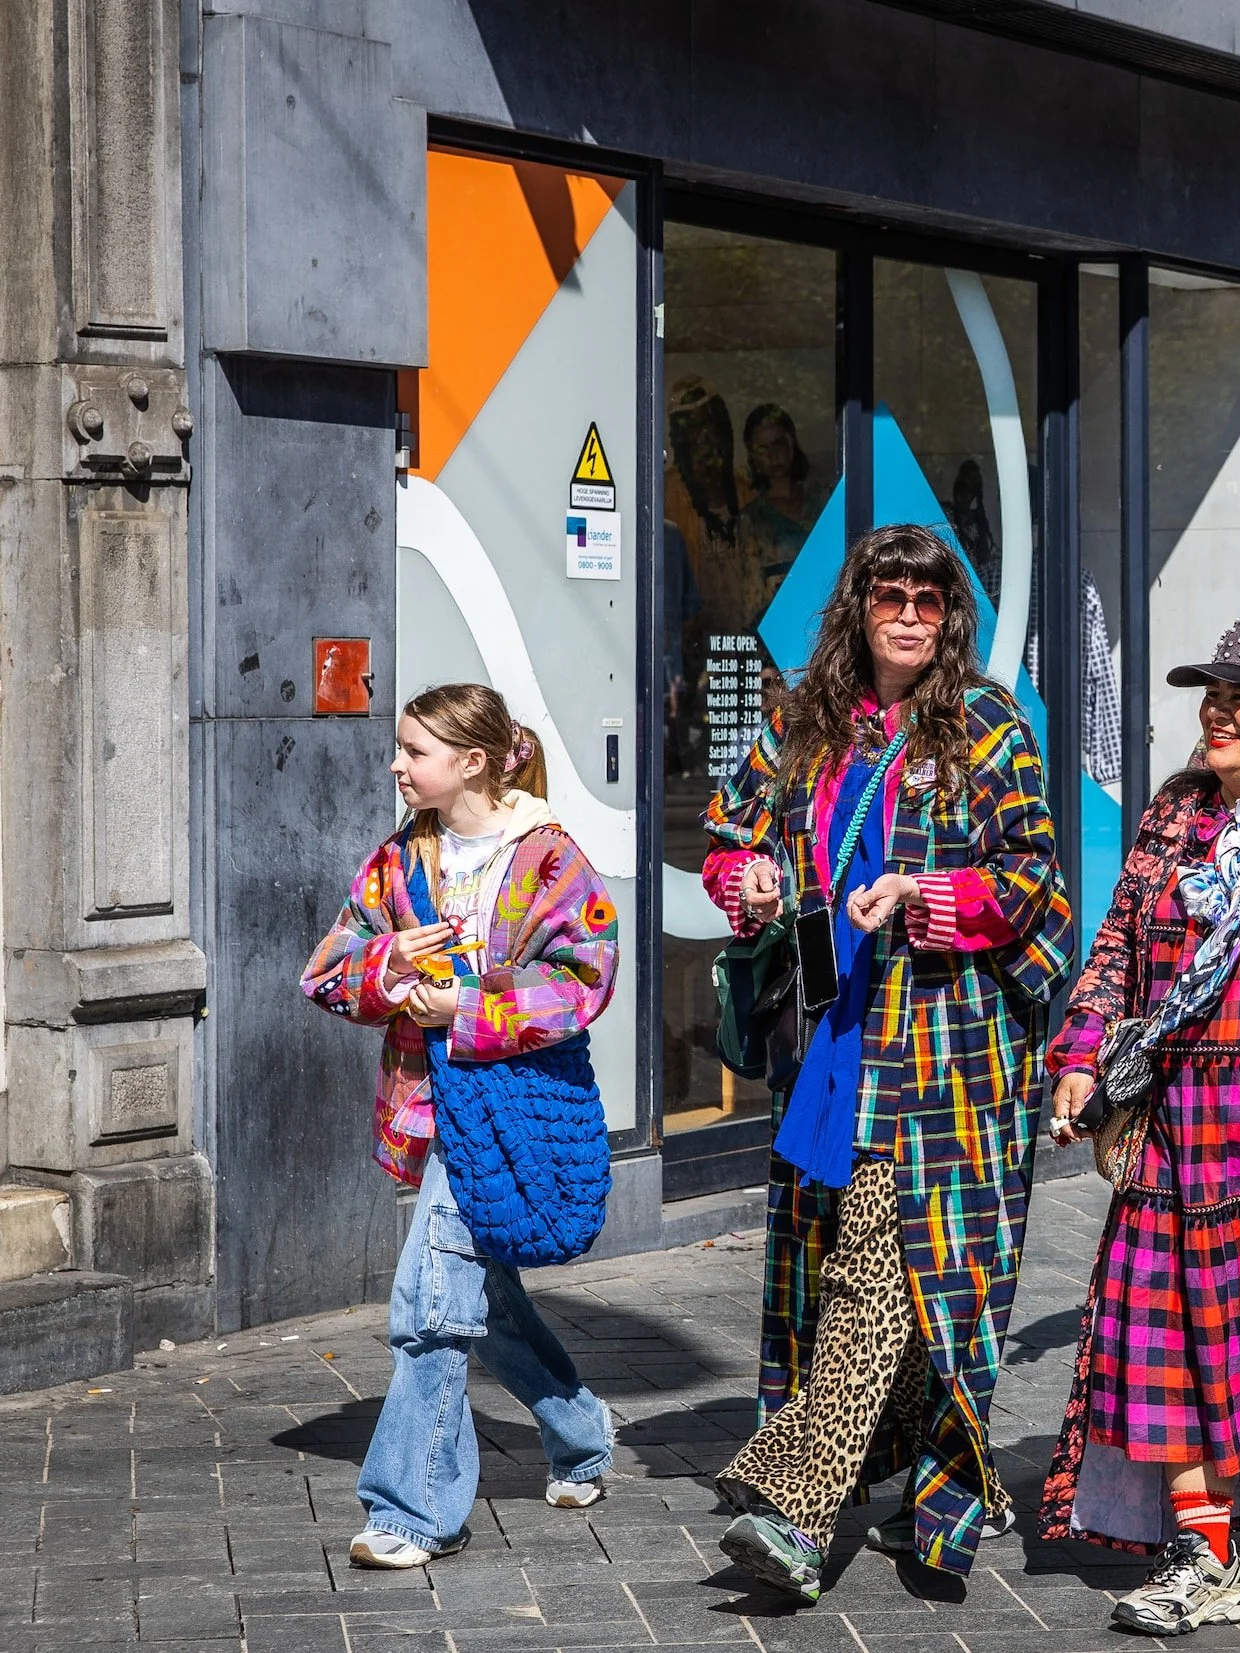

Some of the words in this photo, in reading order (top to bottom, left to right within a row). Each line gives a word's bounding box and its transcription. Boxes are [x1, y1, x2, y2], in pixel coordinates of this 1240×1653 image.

[578, 561, 593, 569] 0800
[597, 561, 612, 570] 9009
[710, 636, 721, 651] WE
[722, 636, 736, 651] ARE
[736, 636, 758, 652] OPEN:
